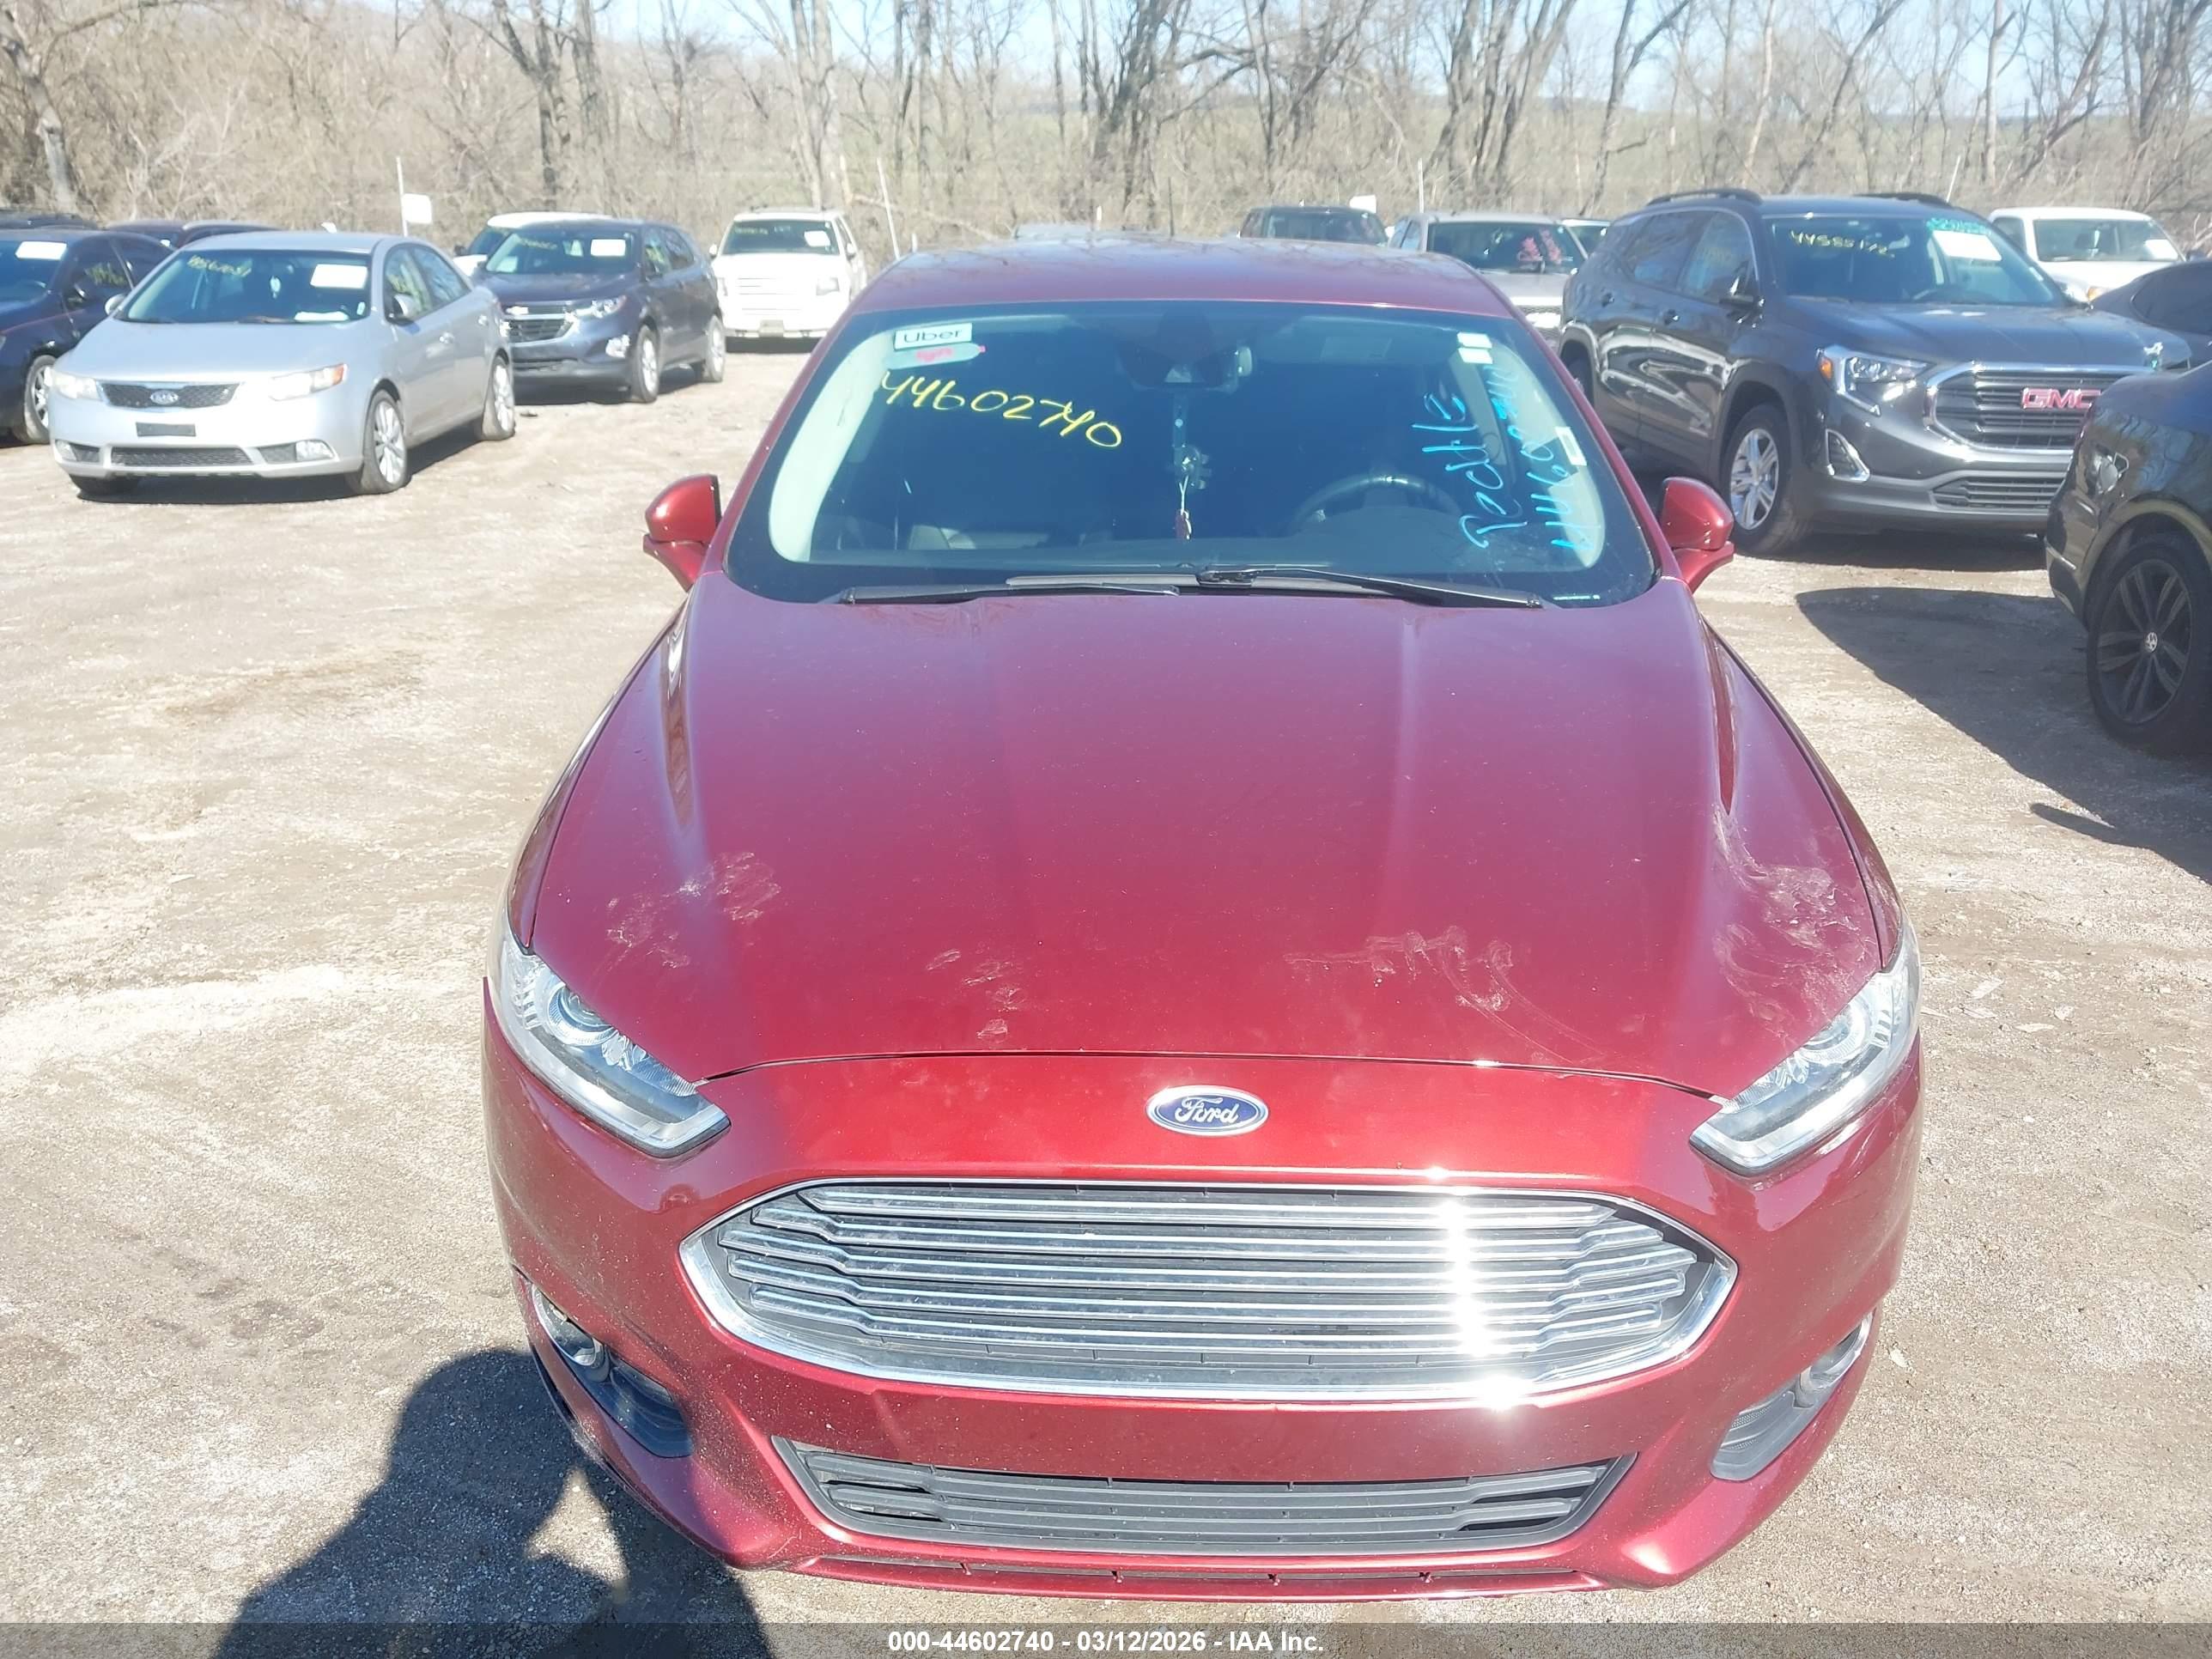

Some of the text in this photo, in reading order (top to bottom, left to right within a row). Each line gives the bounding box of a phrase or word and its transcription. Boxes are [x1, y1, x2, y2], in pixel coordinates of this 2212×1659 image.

[903, 329, 962, 343] Uber
[881, 370, 1122, 448] 44602740
[2021, 386, 2101, 410] GMC
[1174, 1096, 1239, 1124] Ford
